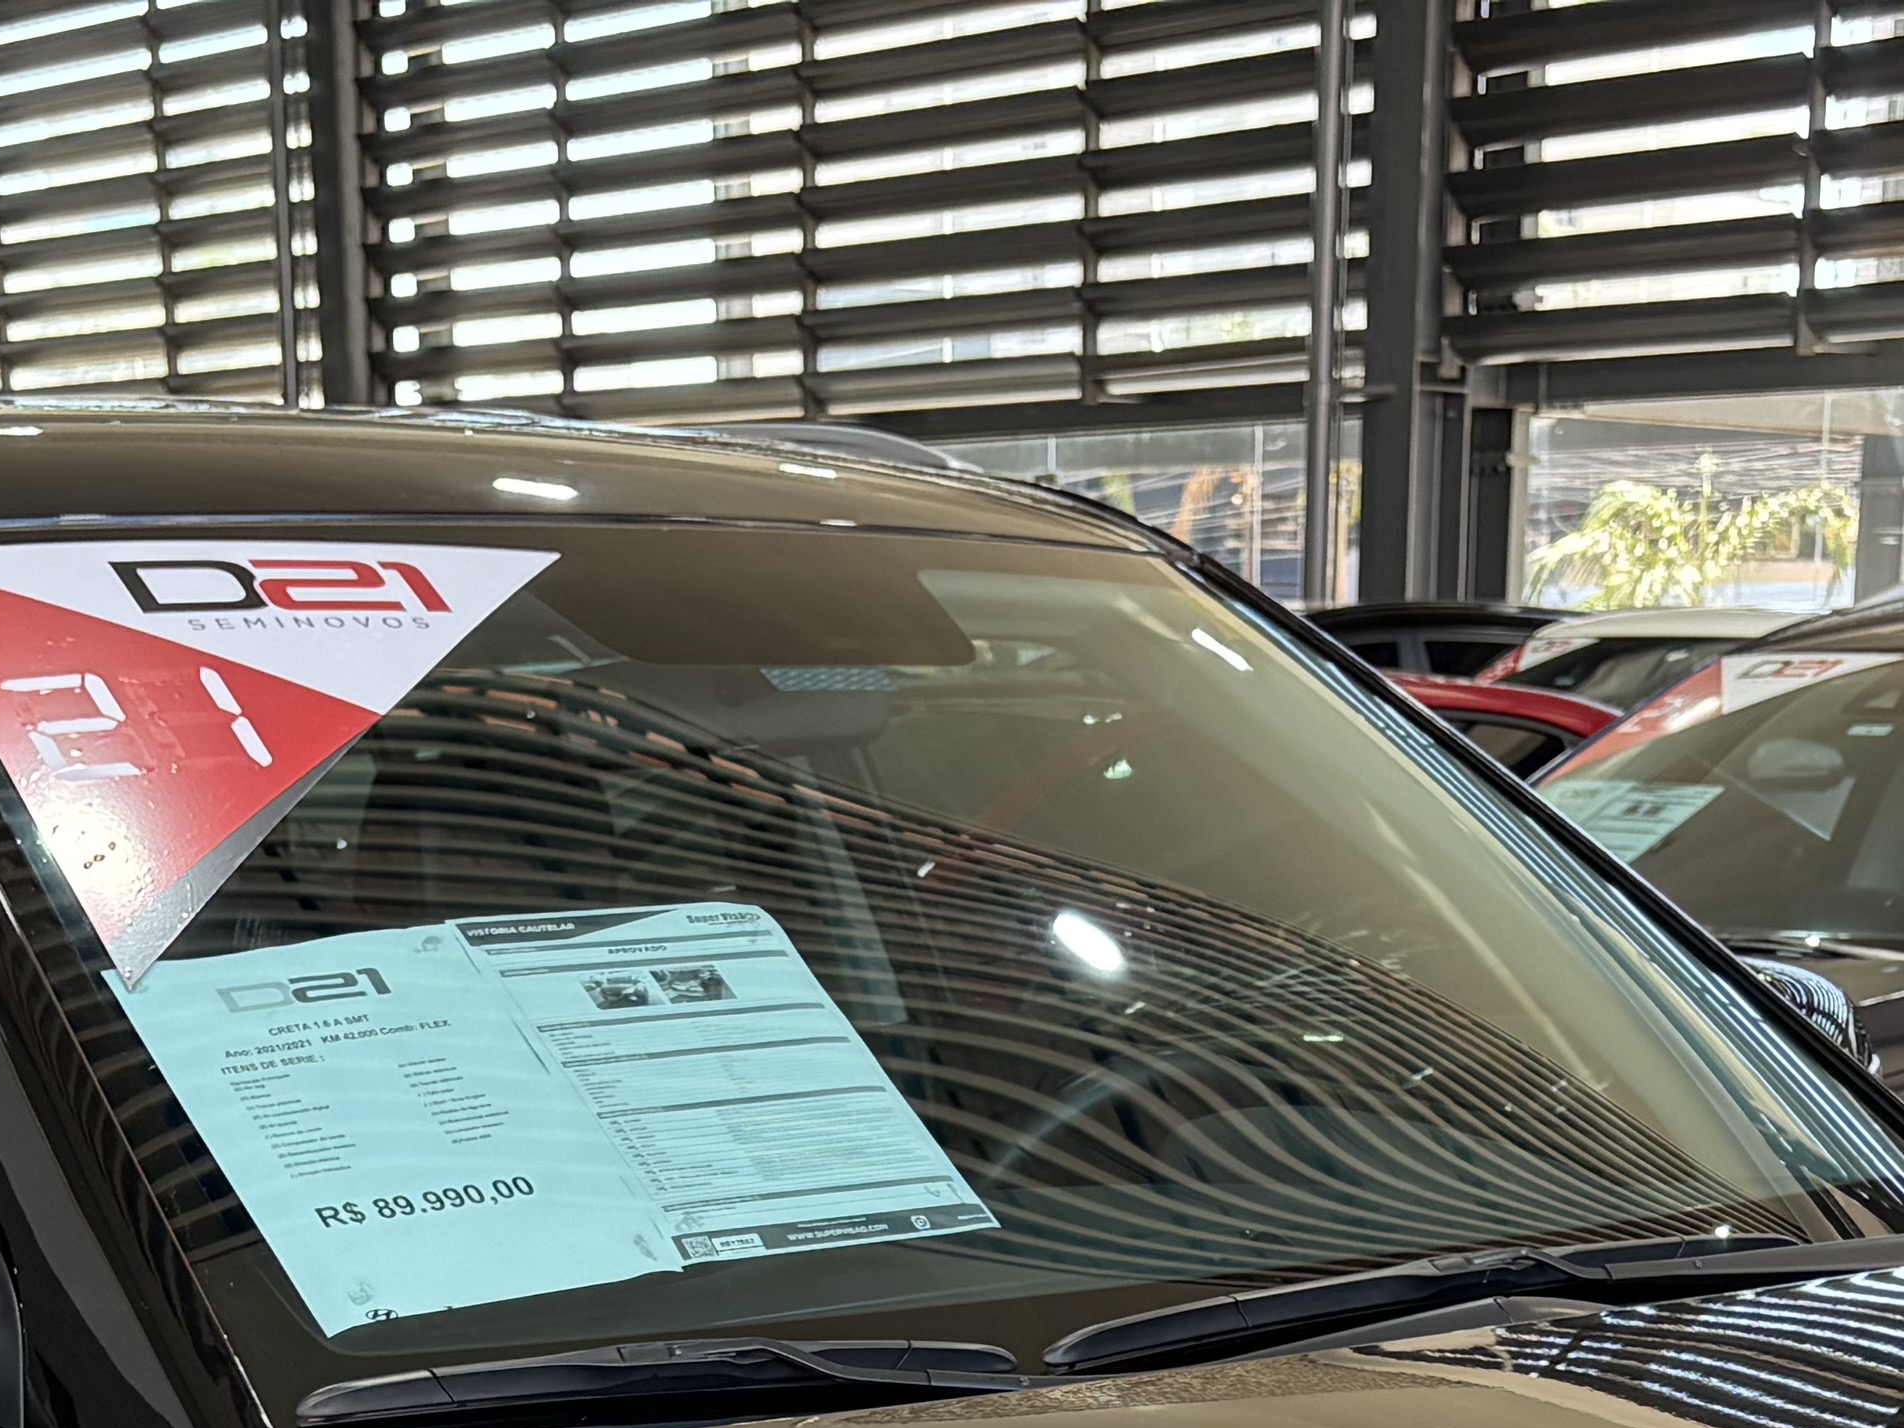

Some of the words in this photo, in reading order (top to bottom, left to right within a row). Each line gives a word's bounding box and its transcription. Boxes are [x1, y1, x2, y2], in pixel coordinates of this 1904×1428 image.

[107, 558, 453, 614] D21
[187, 615, 431, 633] SEMINOVOS
[0, 666, 273, 782] 21
[214, 967, 392, 1014] D21
[225, 1047, 253, 1059] Ano:
[256, 1038, 313, 1056] 2021/2021
[320, 1032, 342, 1044] KM
[268, 1021, 312, 1037] CRETA
[221, 1060, 258, 1075] ITENS
[261, 1058, 278, 1071] DE
[315, 1201, 366, 1228] R$
[372, 1176, 535, 1219] 89.990,00
